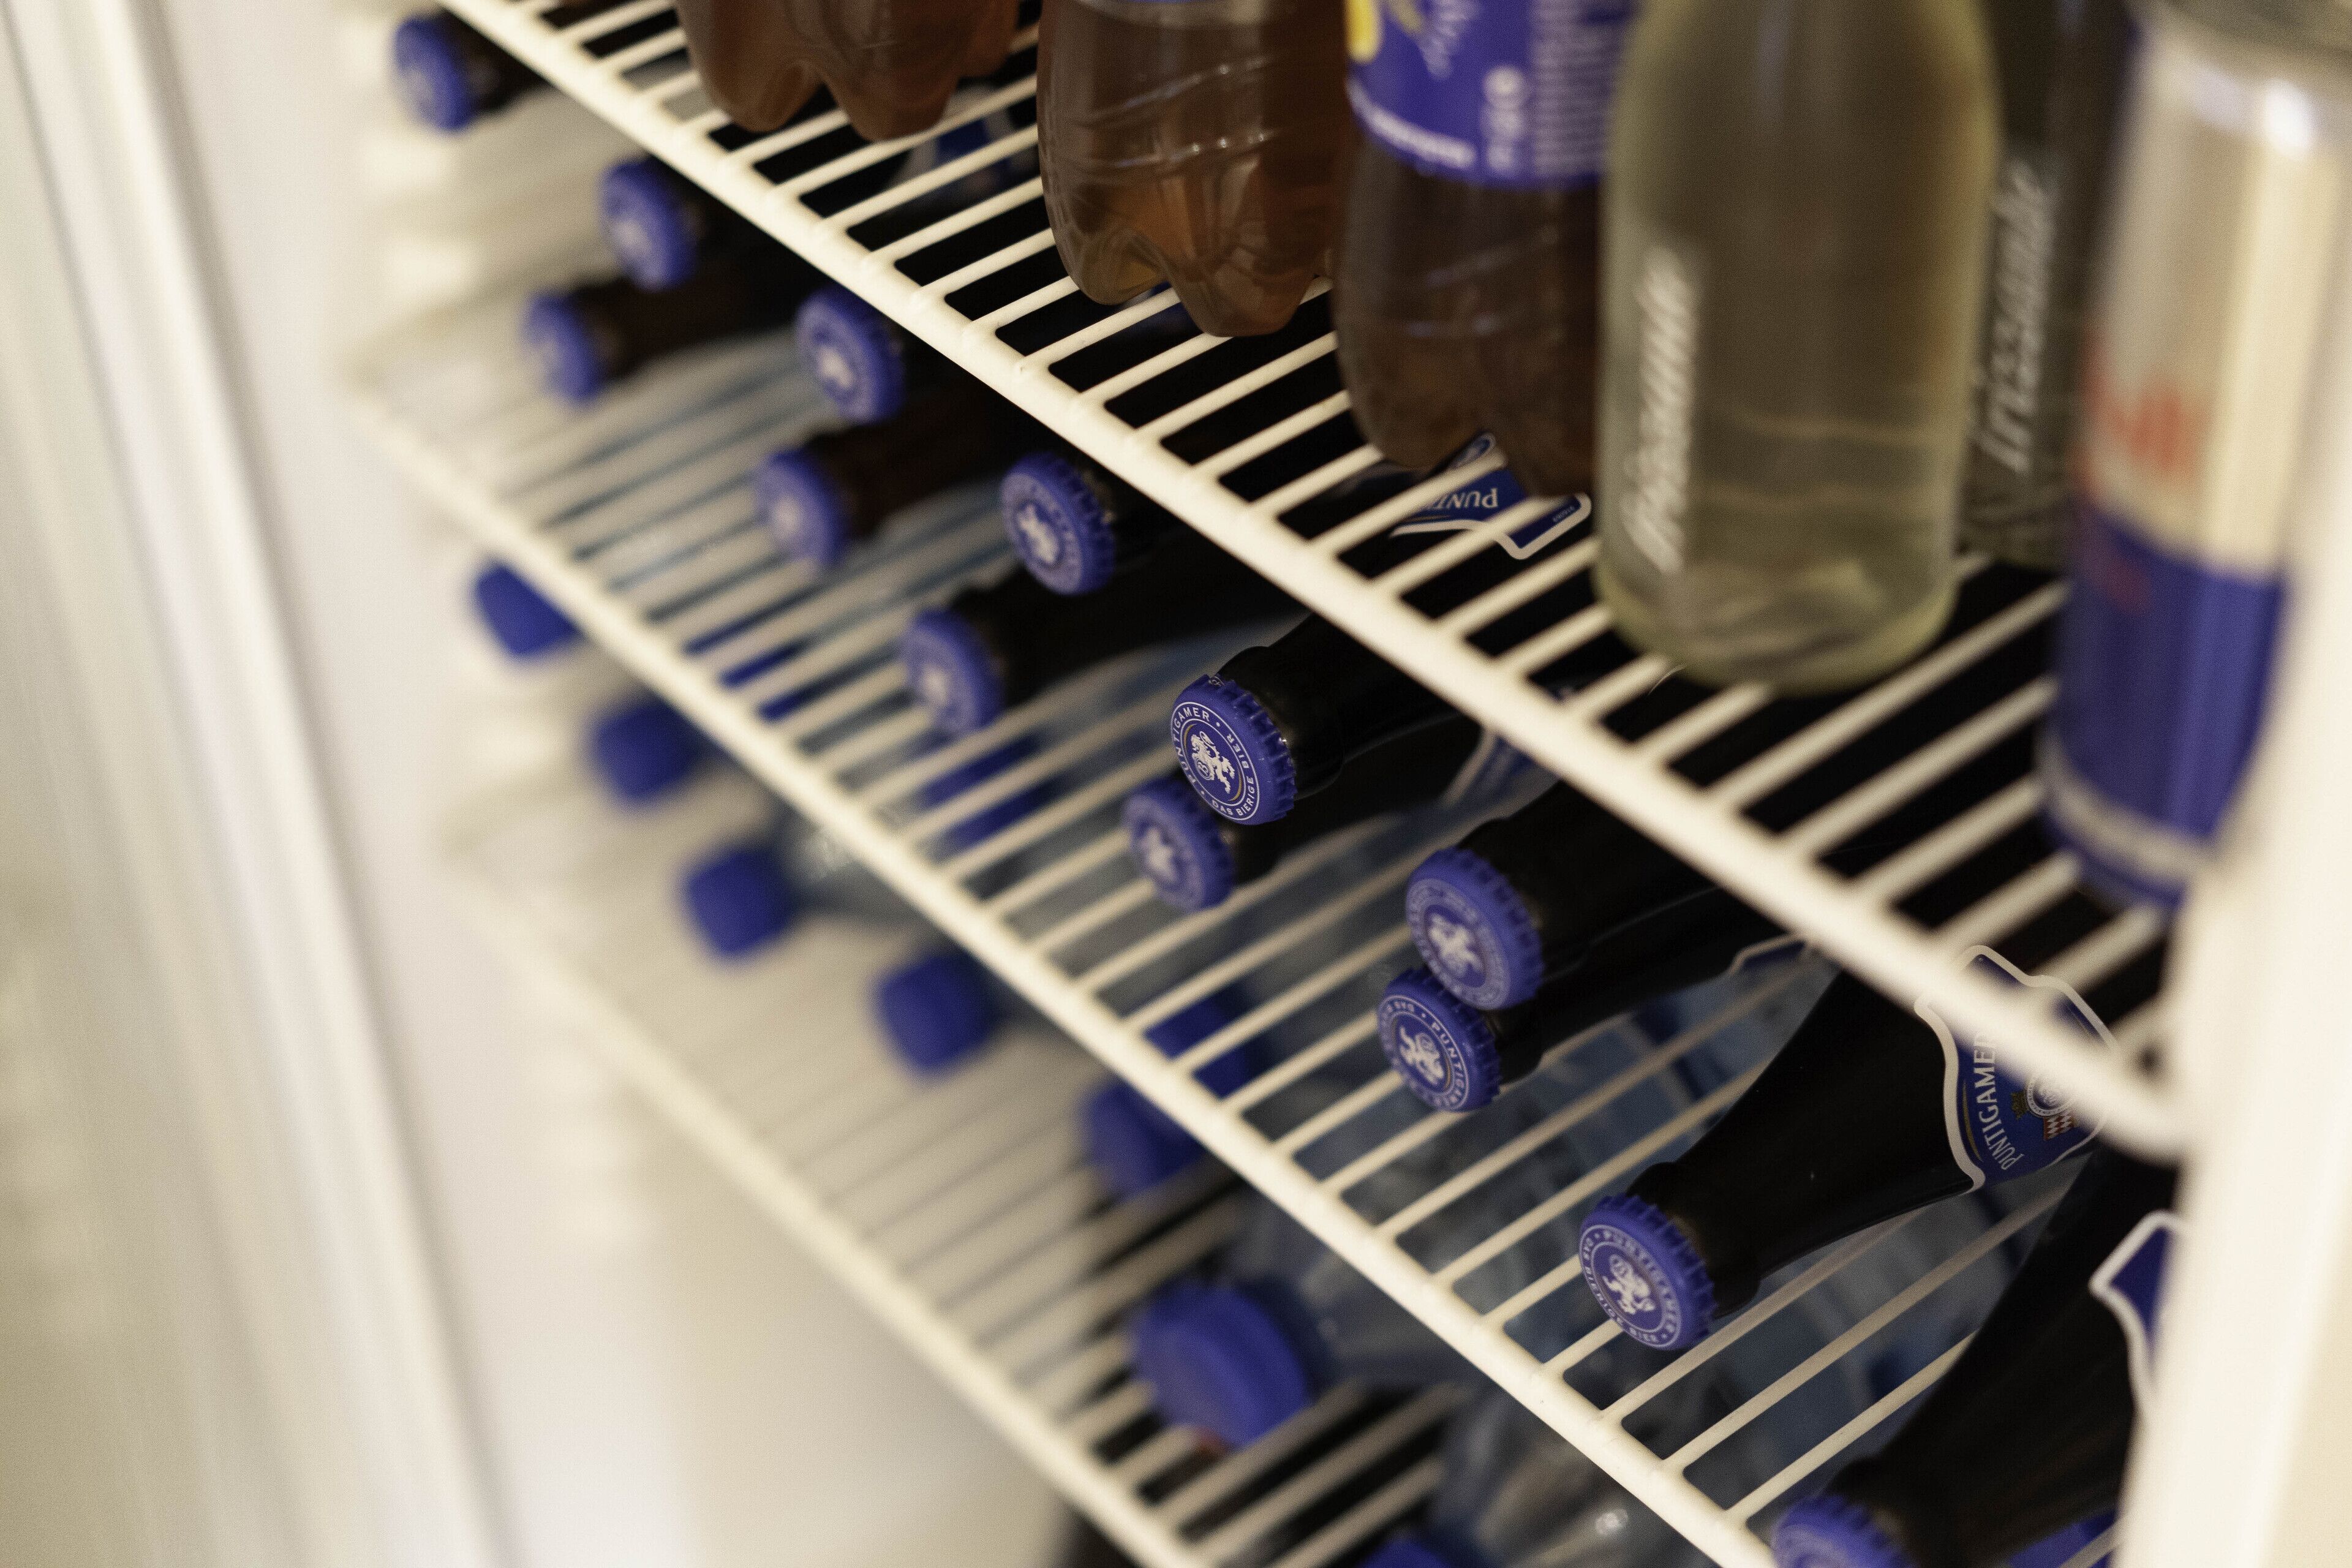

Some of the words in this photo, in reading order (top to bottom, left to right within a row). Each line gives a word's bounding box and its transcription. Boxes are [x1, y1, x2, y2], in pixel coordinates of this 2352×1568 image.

[1428, 488, 1499, 510] PUNT
[1172, 707, 1210, 784] PUNTIGAMER
[1226, 733, 1250, 769] BIER
[1212, 800, 1234, 816] DAS
[1235, 775, 1256, 816] BIERIGE
